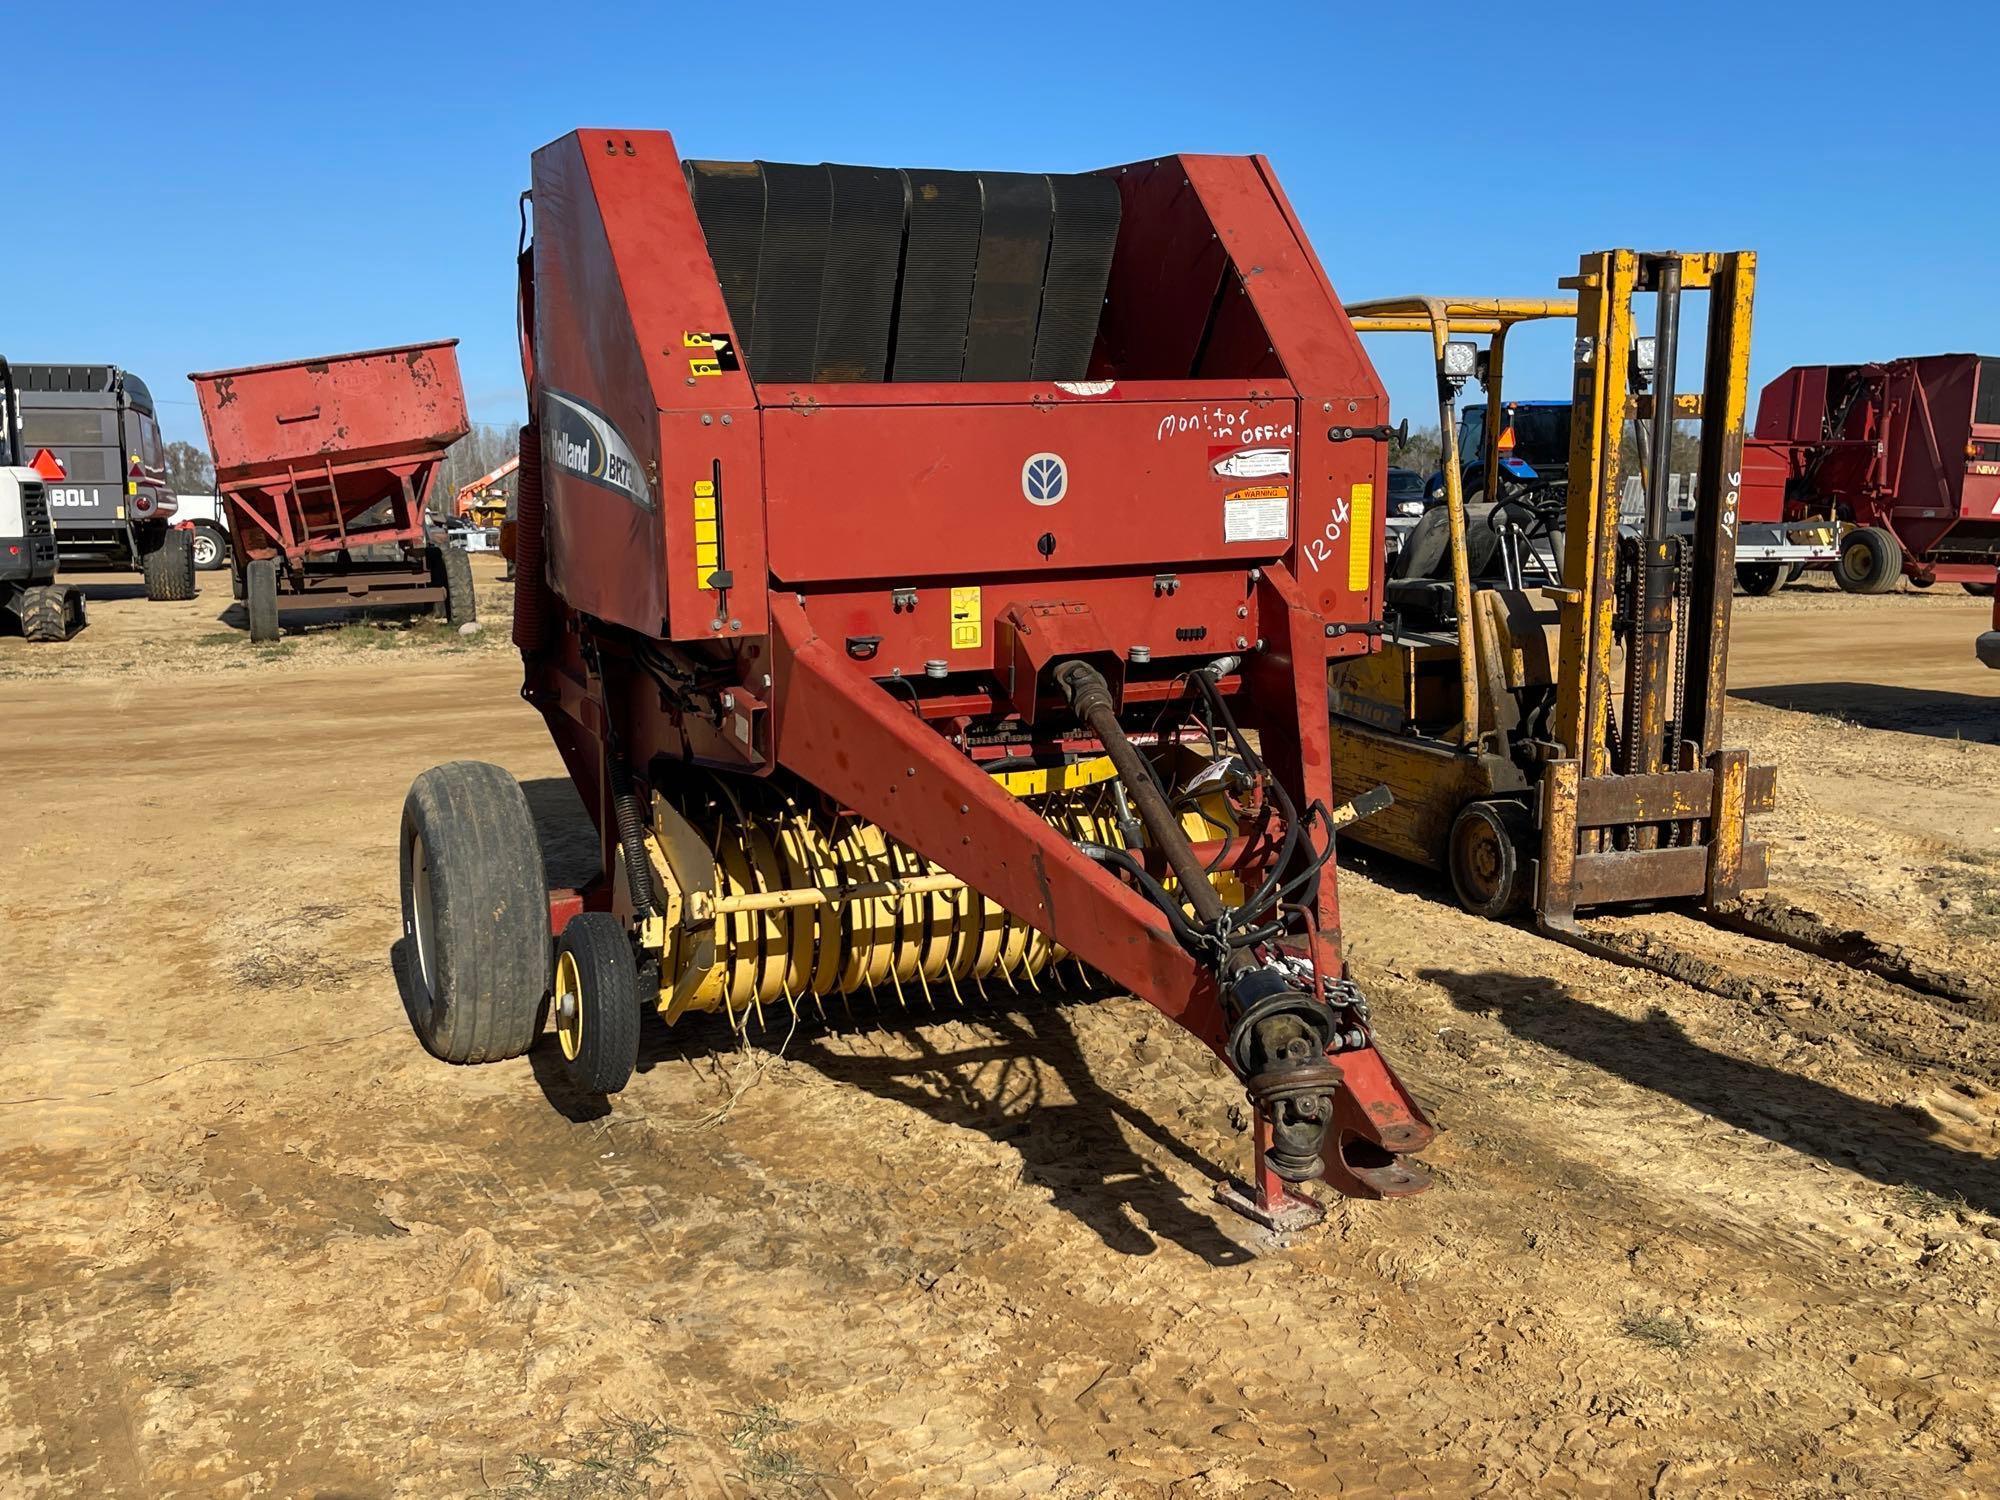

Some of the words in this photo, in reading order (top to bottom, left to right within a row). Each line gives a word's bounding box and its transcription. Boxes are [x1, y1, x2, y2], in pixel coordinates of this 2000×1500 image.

[48, 488, 99, 507] BOLI
[1244, 489, 1278, 498] WARNING
[1721, 471, 1741, 538] 1206
[1303, 497, 1349, 572] 1204
